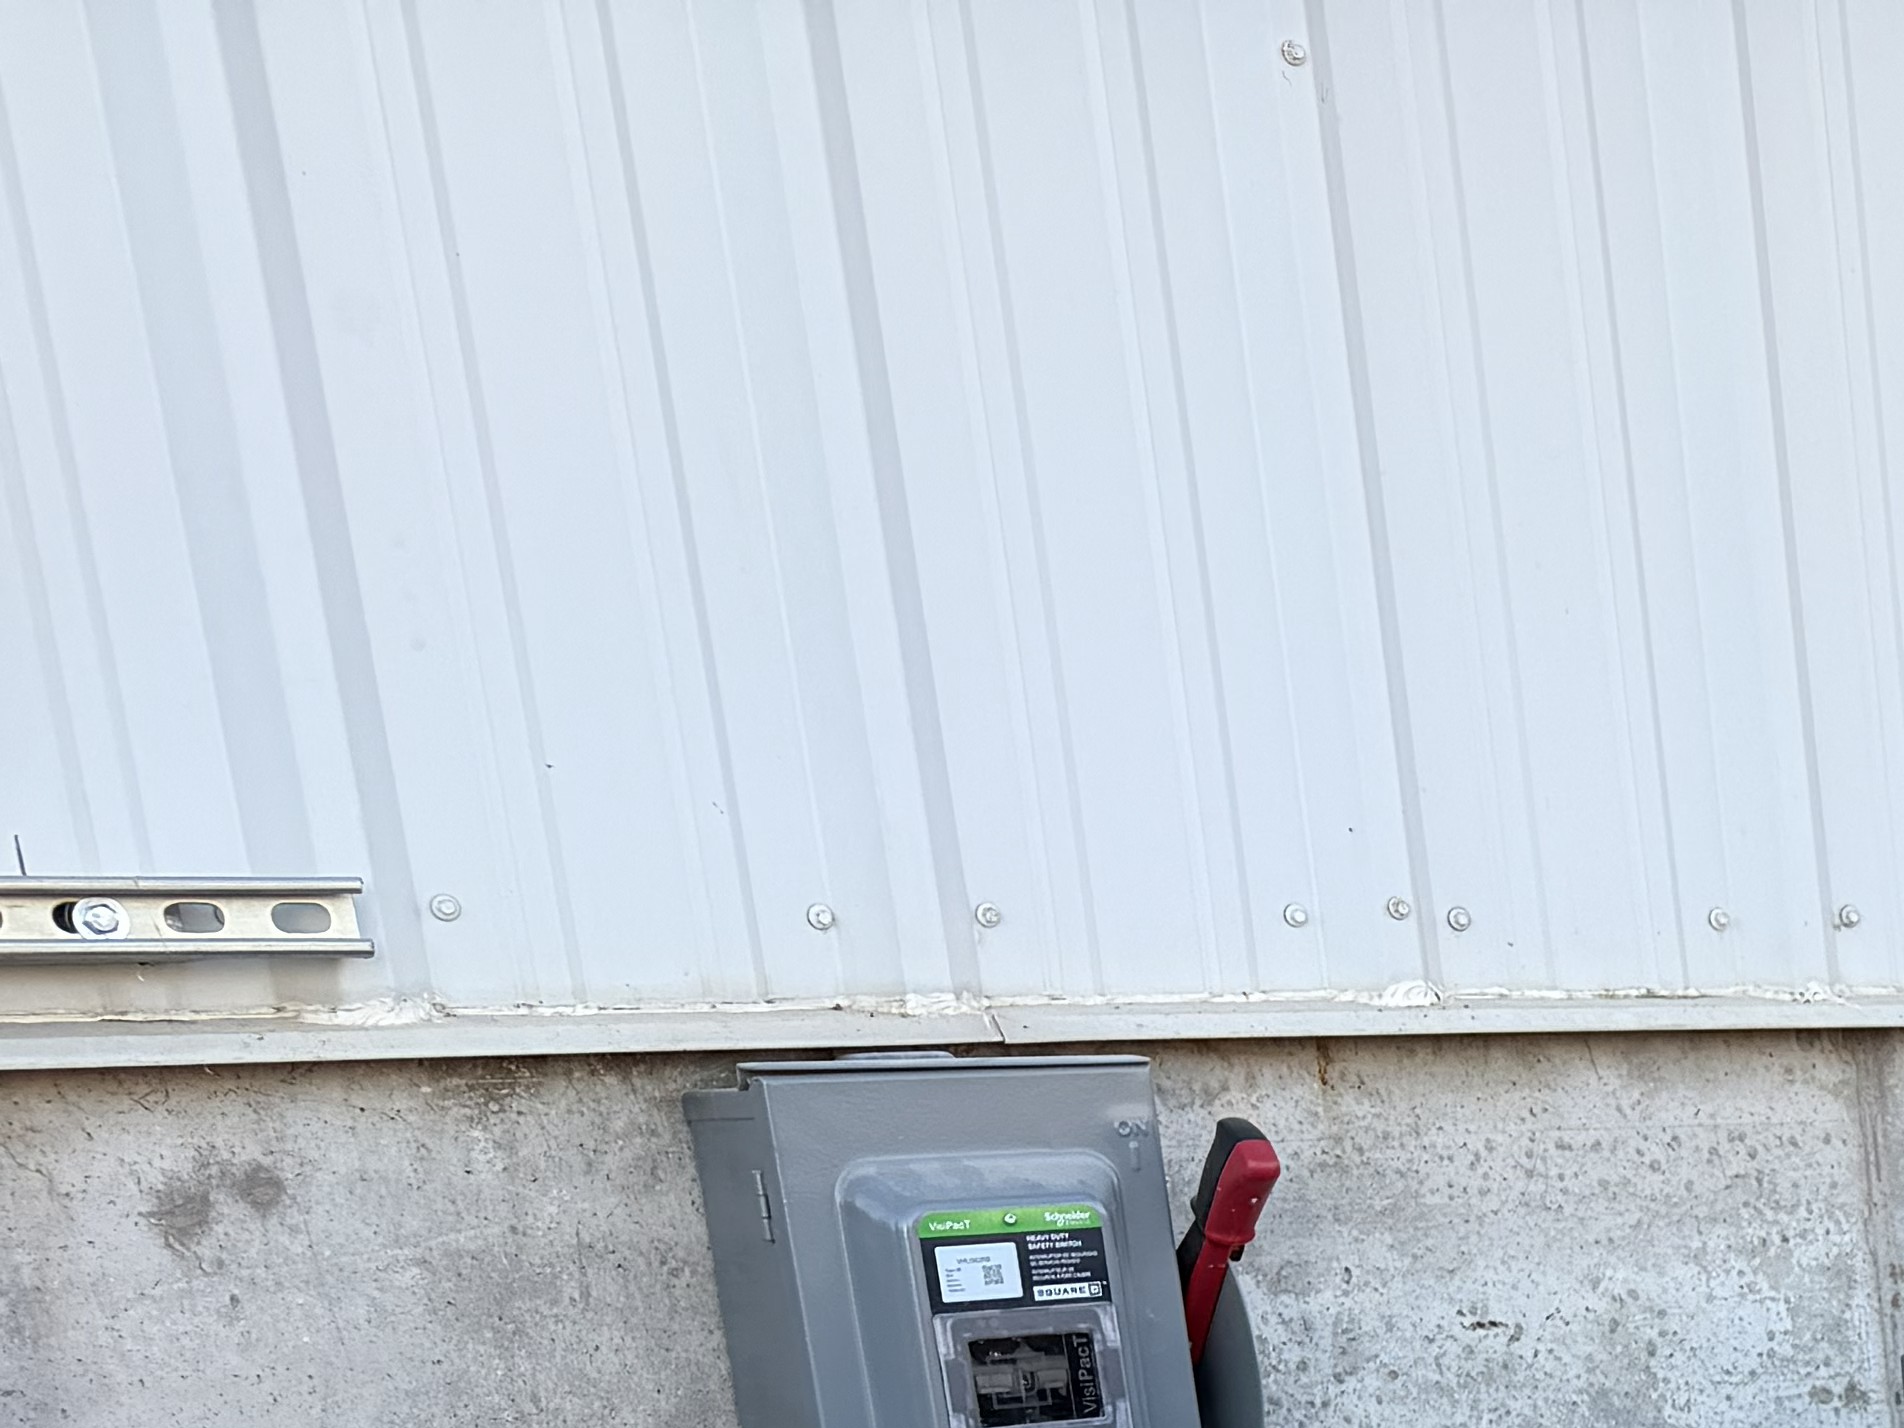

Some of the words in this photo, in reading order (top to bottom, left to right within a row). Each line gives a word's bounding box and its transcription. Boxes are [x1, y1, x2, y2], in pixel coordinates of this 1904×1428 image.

[1116, 1120, 1149, 1137] ON
[1044, 1211, 1090, 1226] Schneider
[1037, 1286, 1087, 1297] SQUARE
[1072, 1335, 1097, 1415] VisiPacT
